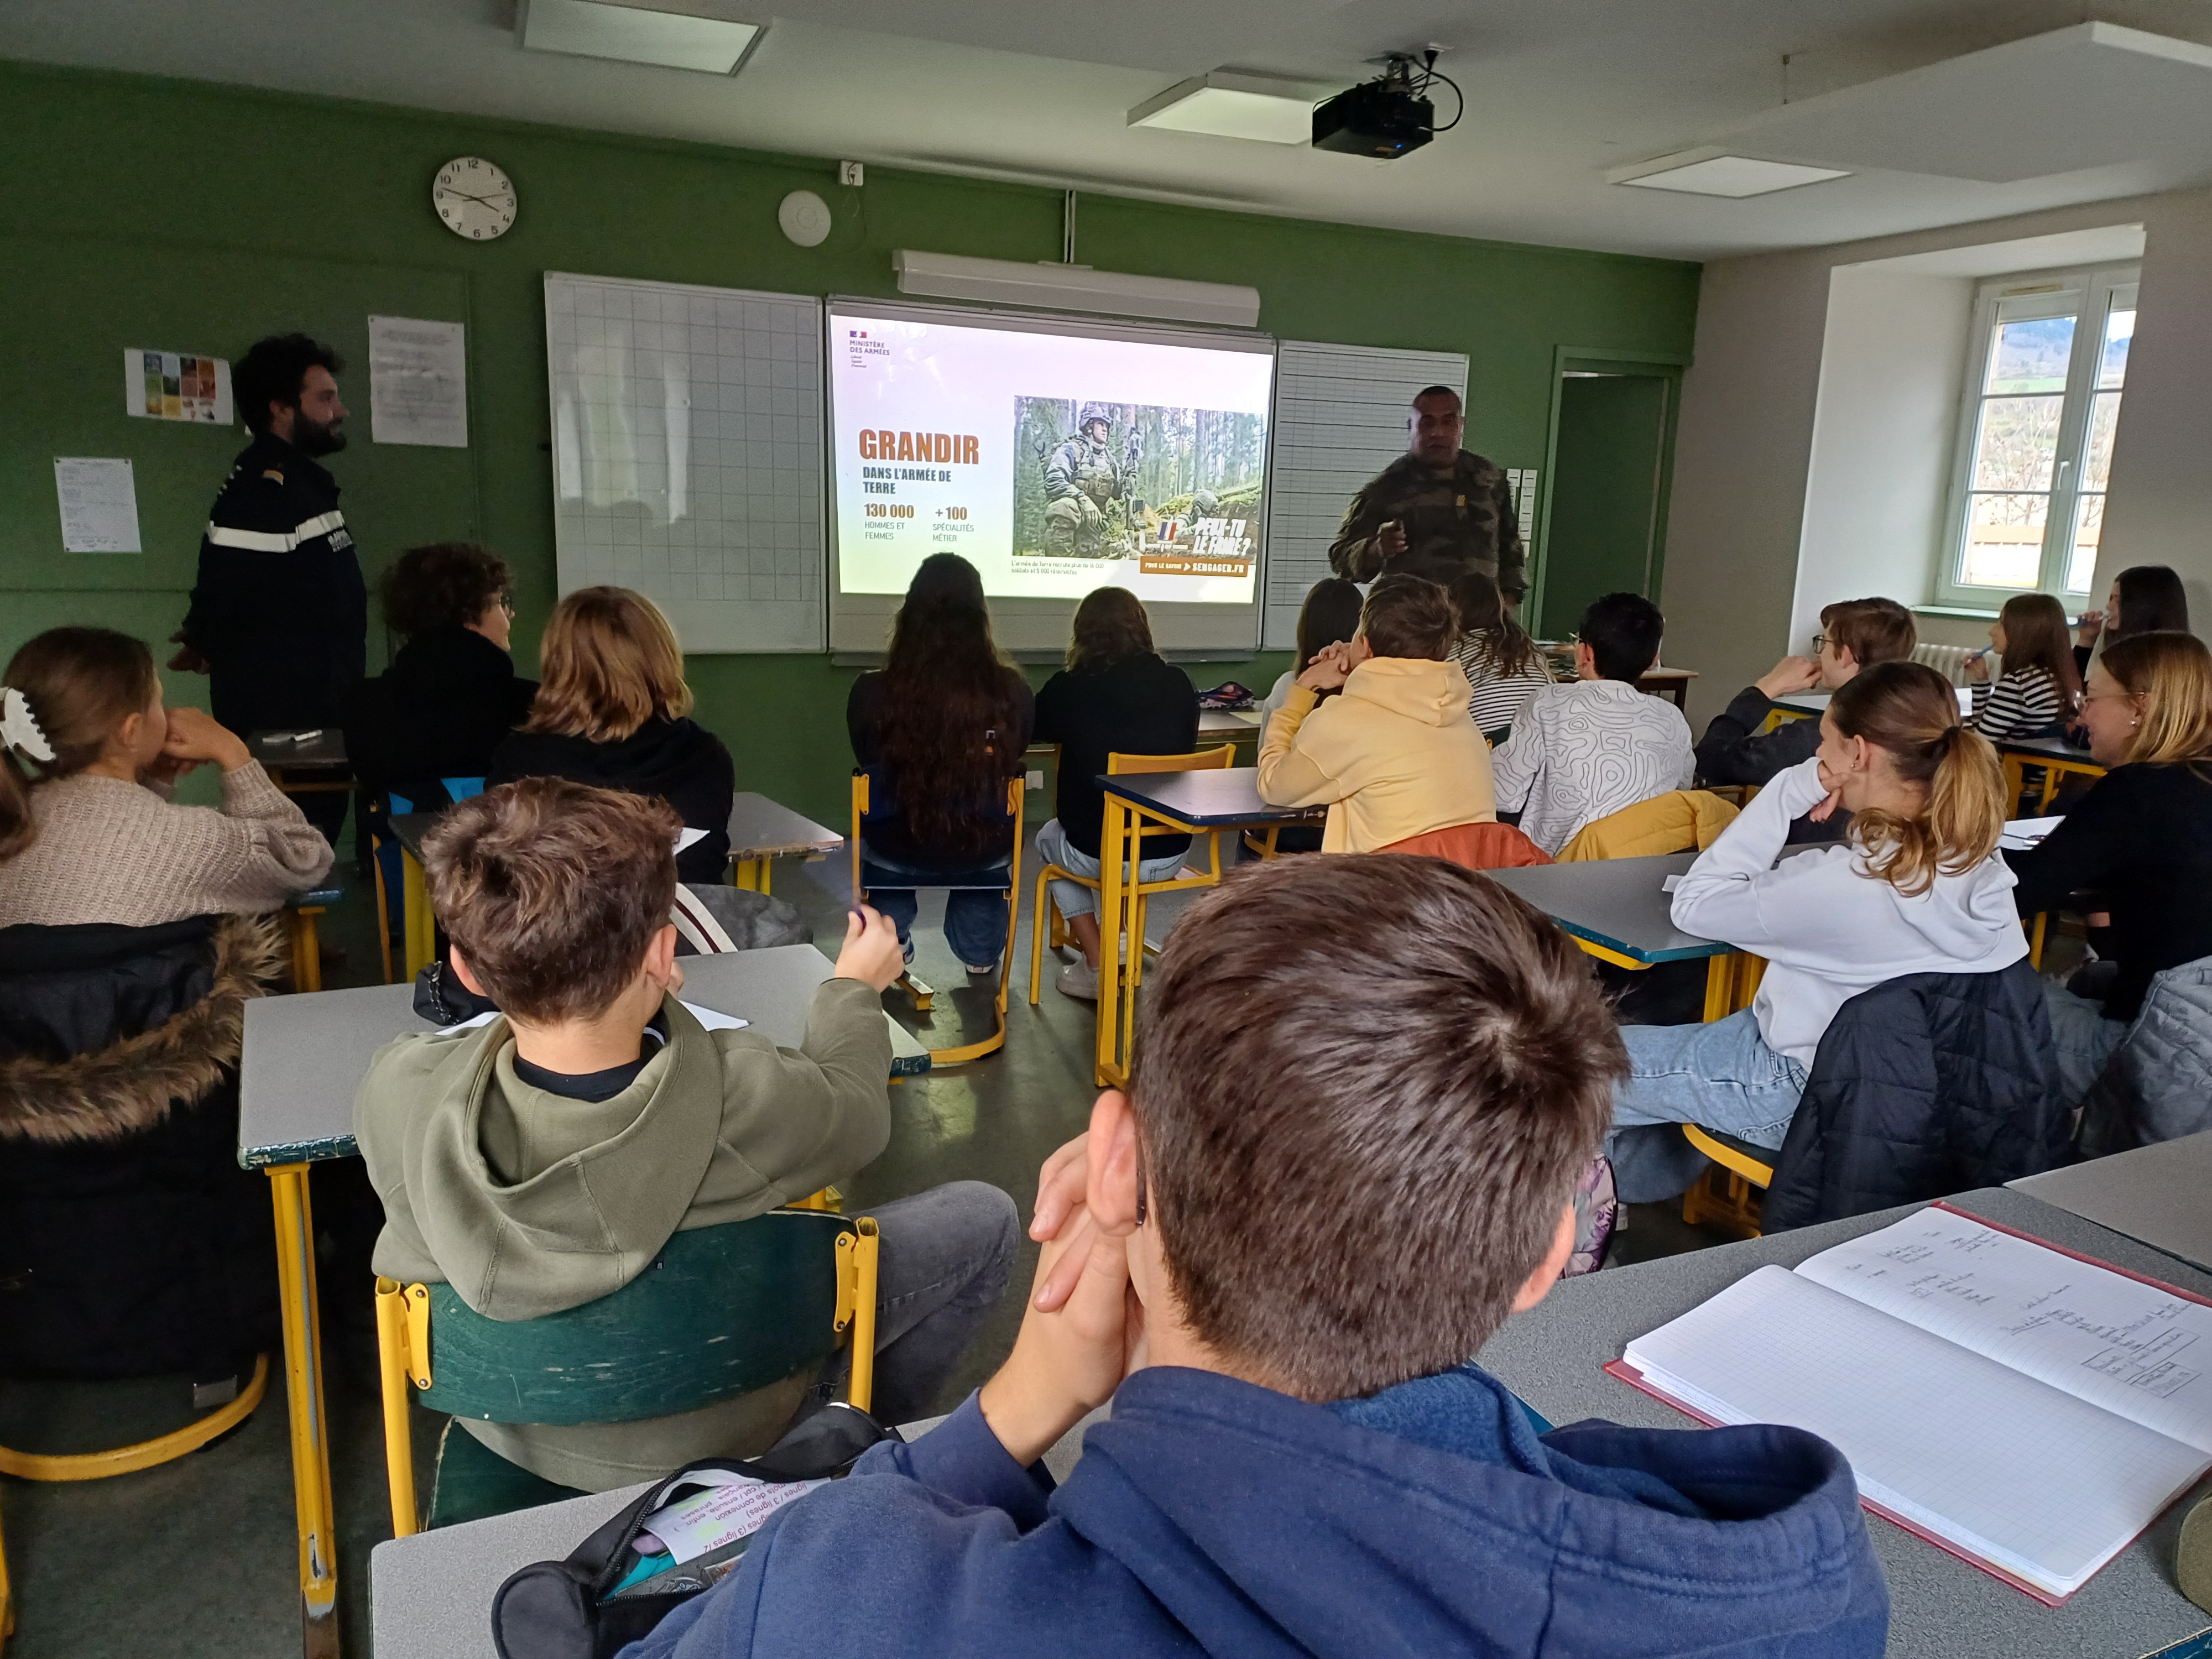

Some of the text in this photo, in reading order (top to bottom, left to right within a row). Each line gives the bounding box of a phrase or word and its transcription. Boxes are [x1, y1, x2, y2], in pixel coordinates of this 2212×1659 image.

[451, 163, 460, 173] 11
[468, 159, 478, 169] 12
[490, 168, 494, 176] 1
[441, 175, 451, 185] 10
[502, 180, 509, 190] 2
[436, 191, 444, 200] 9
[507, 198, 514, 207] 3
[442, 208, 449, 218] 8
[503, 214, 510, 223] 4
[456, 222, 462, 231] 7
[491, 225, 498, 235] 5
[474, 229, 481, 238] 6
[849, 340, 885, 348] MINISTÈRE
[859, 429, 979, 465] GRANDIR
[863, 466, 892, 479] DANS
[938, 470, 952, 482] DE
[863, 481, 896, 494] TERRE
[864, 503, 915, 518] 130 000
[935, 506, 967, 520] + 100
[864, 521, 895, 530] HOMMES
[932, 522, 974, 532] SPÉCIALITÉS
[865, 531, 894, 540] FEMMES
[932, 533, 957, 542] MÉTIER
[1192, 535, 1209, 554] LE
[784, 1482, 807, 1498] lignes
[755, 1492, 766, 1500] de
[714, 1498, 755, 1521] connexion
[746, 1500, 773, 1518] lignes)
[738, 1525, 747, 1536] (3
[713, 1531, 738, 1547] lignes
